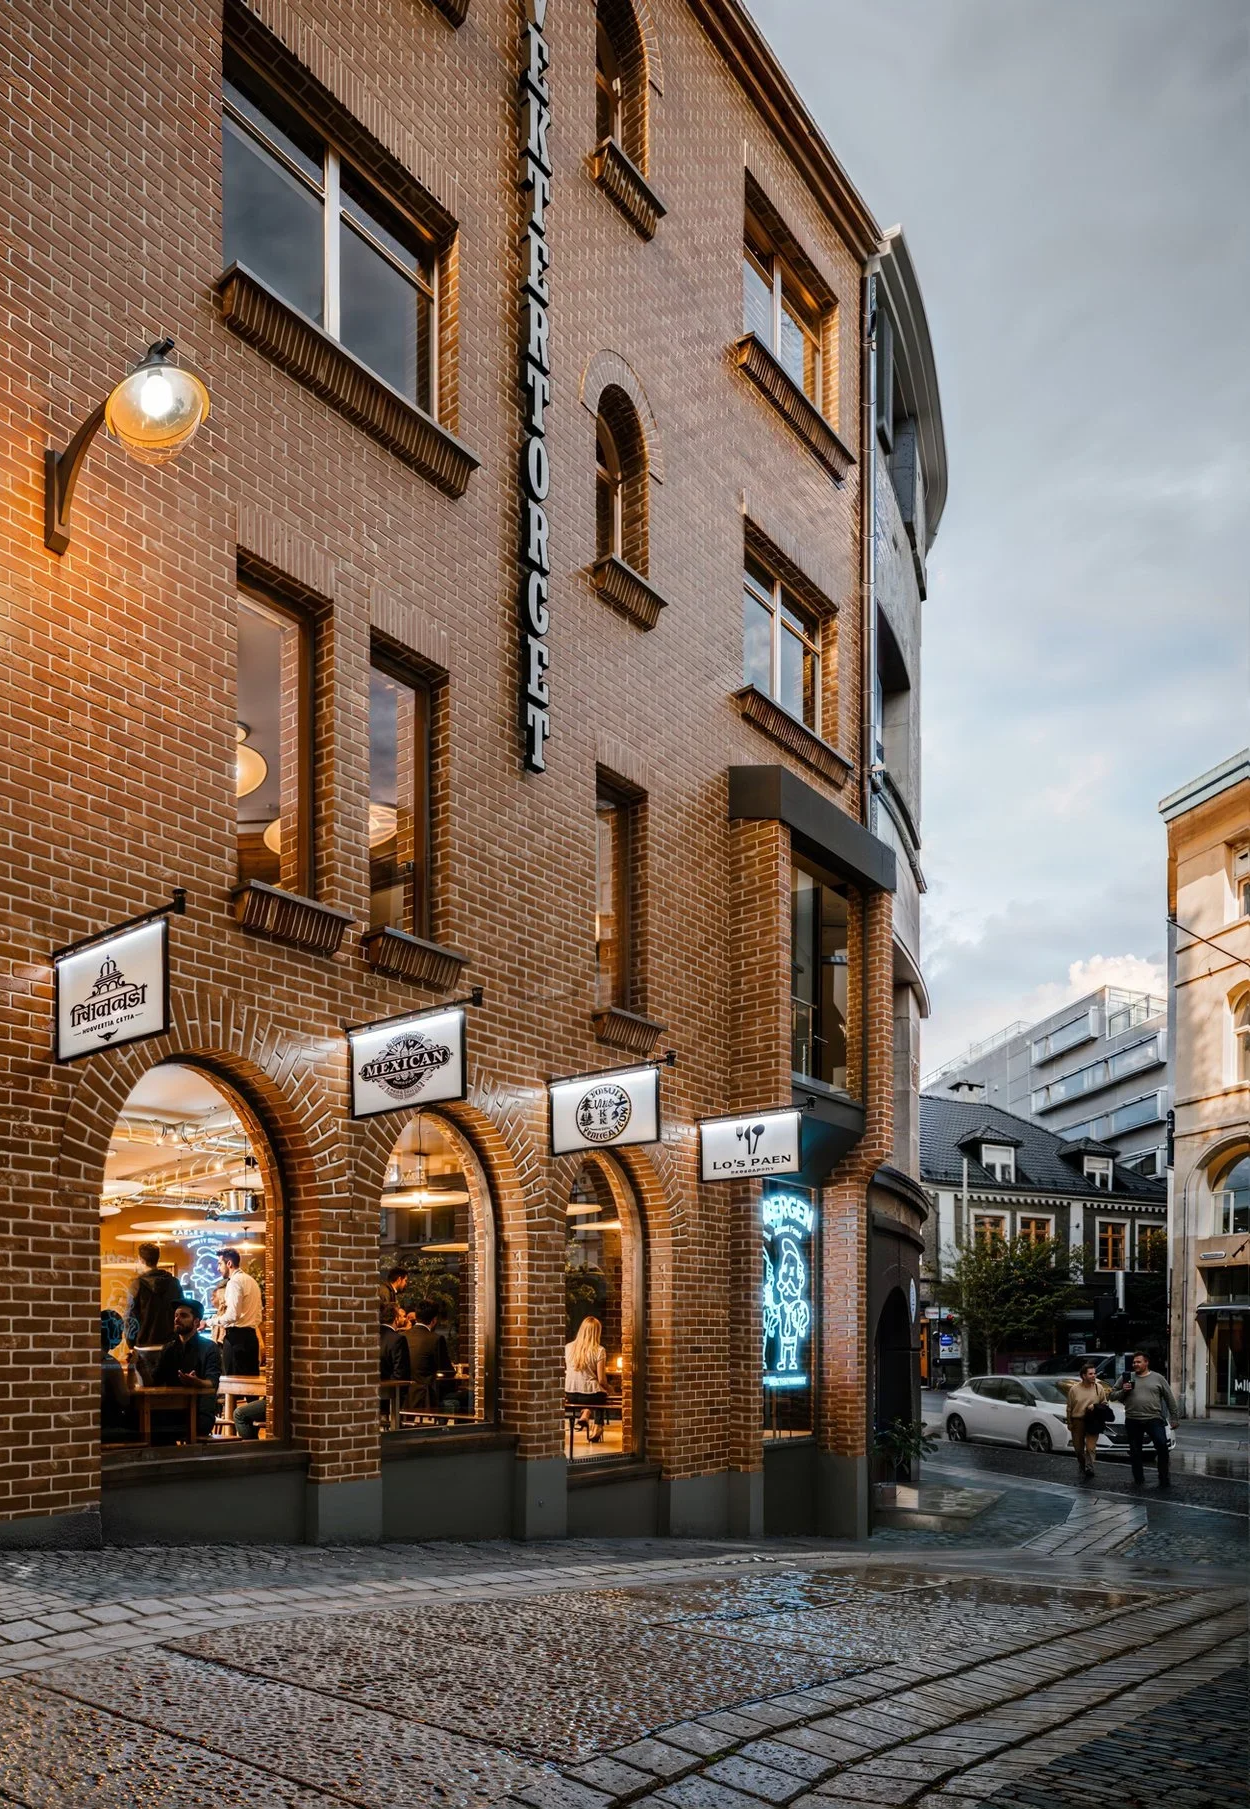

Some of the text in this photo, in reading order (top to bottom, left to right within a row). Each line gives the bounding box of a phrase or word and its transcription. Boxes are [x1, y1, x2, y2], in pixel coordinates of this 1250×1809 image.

[365, 1049, 445, 1077] MEXICAN
[712, 1154, 791, 1170] LO'S PAEN
